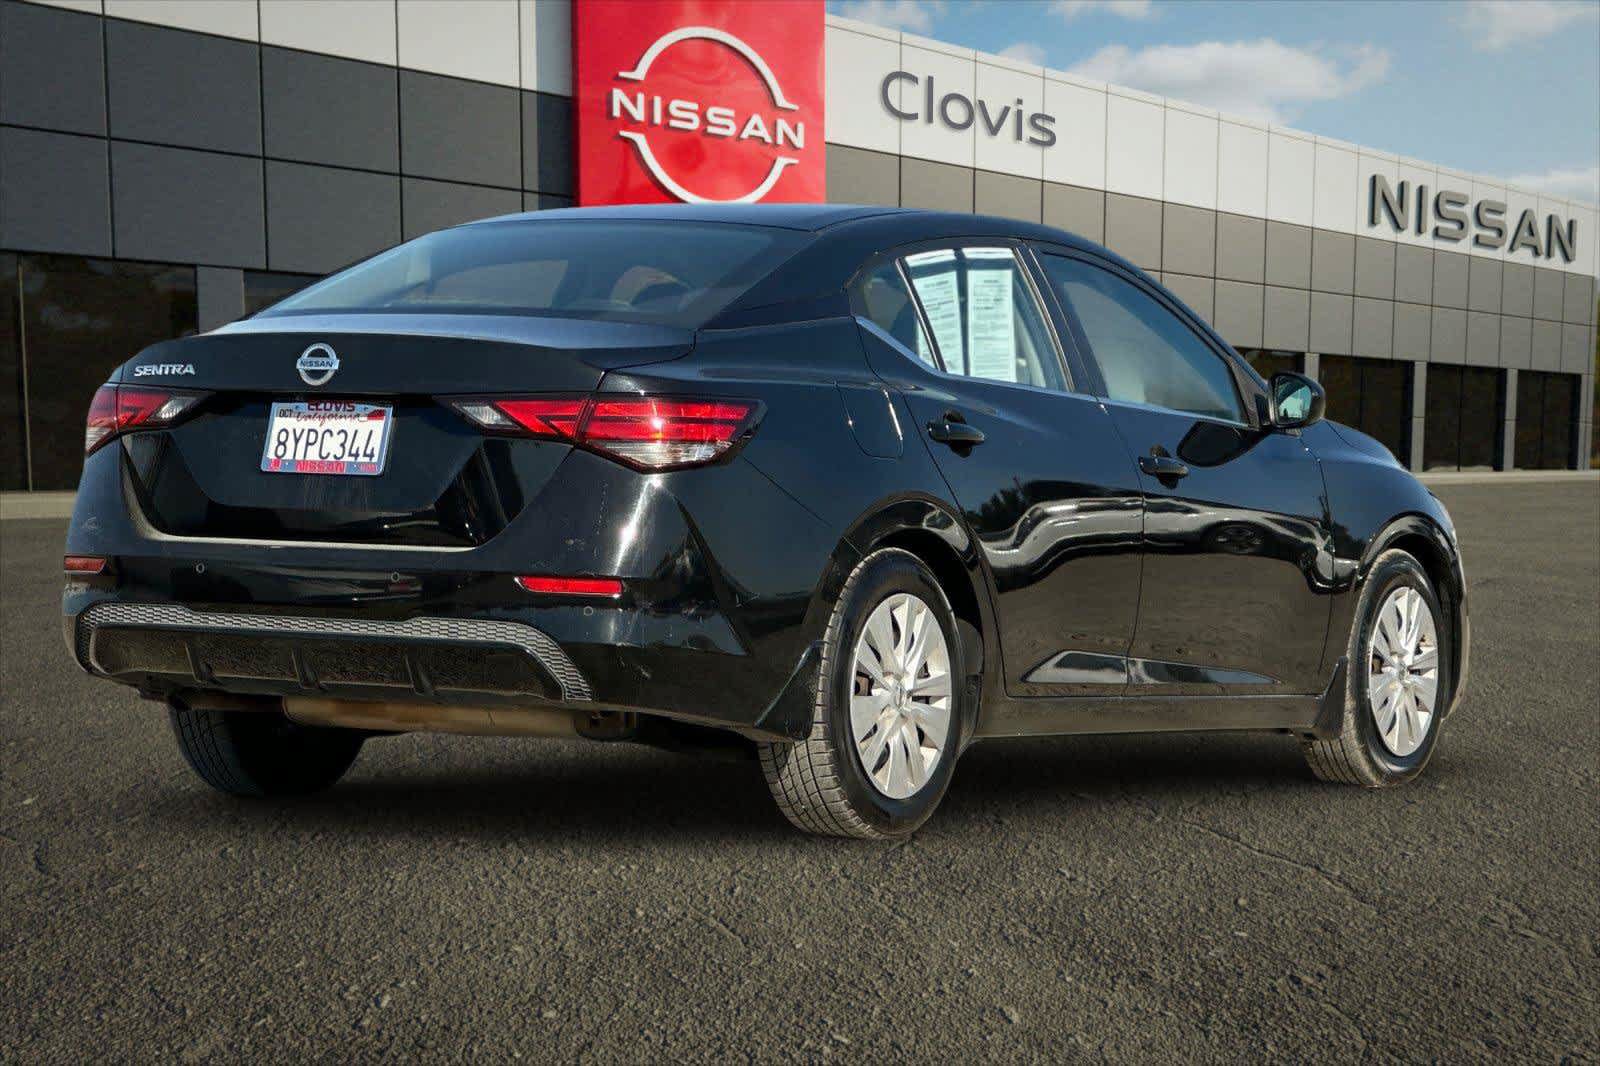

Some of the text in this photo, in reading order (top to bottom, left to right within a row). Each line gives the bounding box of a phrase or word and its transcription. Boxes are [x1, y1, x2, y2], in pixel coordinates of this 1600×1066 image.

[611, 88, 805, 148] NISSAN
[881, 71, 1057, 147] Clovis
[1369, 173, 1578, 263] NISSAN
[134, 364, 196, 377] SENTRA
[300, 359, 334, 368] NISSAN
[296, 411, 361, 427] California
[274, 427, 376, 461] 8YPC344
